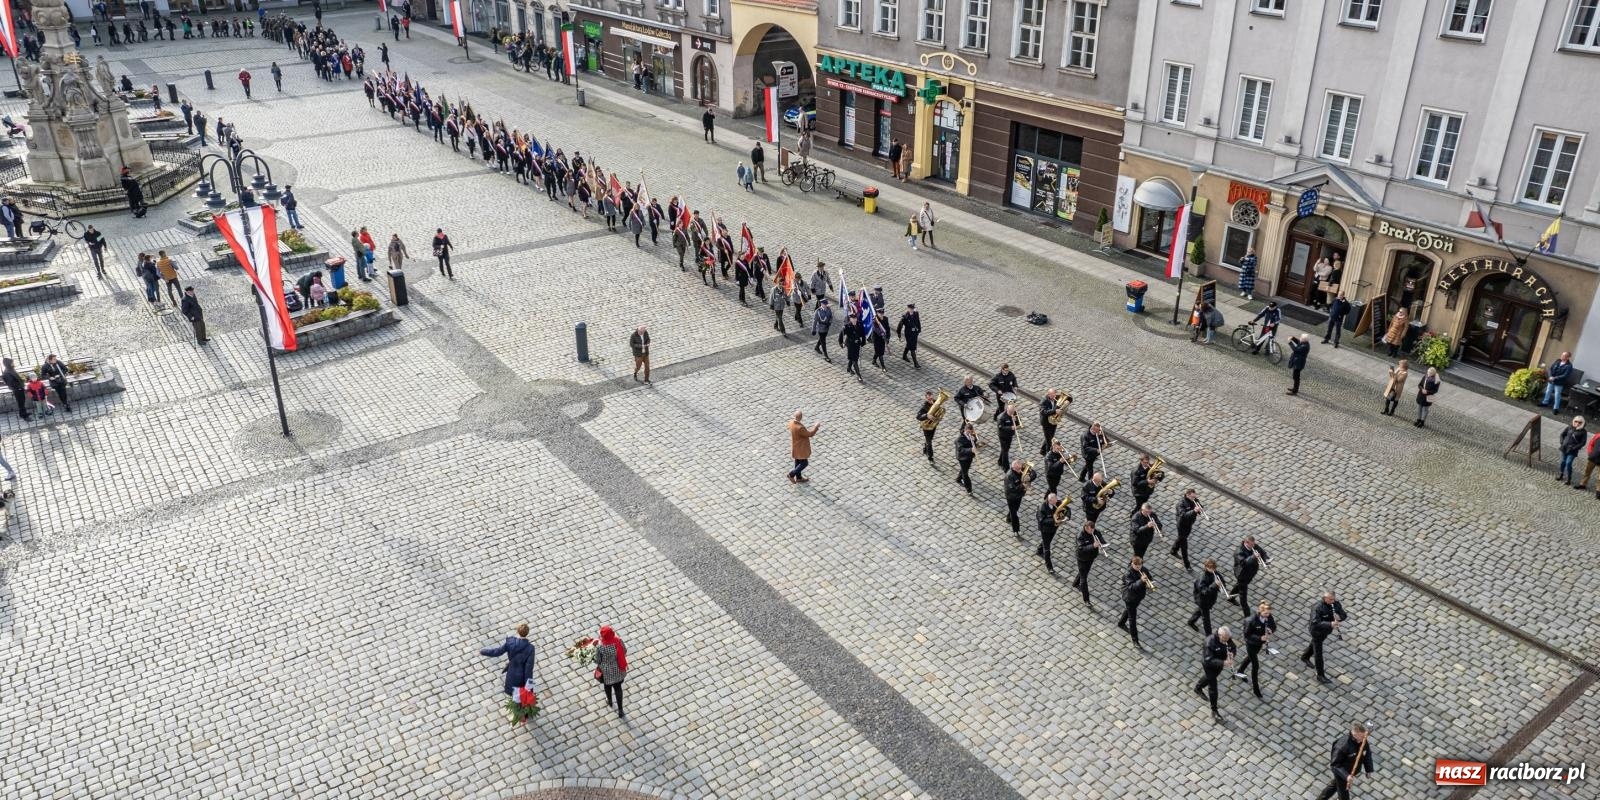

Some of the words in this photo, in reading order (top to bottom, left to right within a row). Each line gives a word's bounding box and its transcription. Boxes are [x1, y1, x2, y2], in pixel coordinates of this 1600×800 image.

[820, 54, 905, 90] APTEKA
[1229, 182, 1268, 213] KANTOR
[1438, 259, 1555, 317] RESTAURACJA
